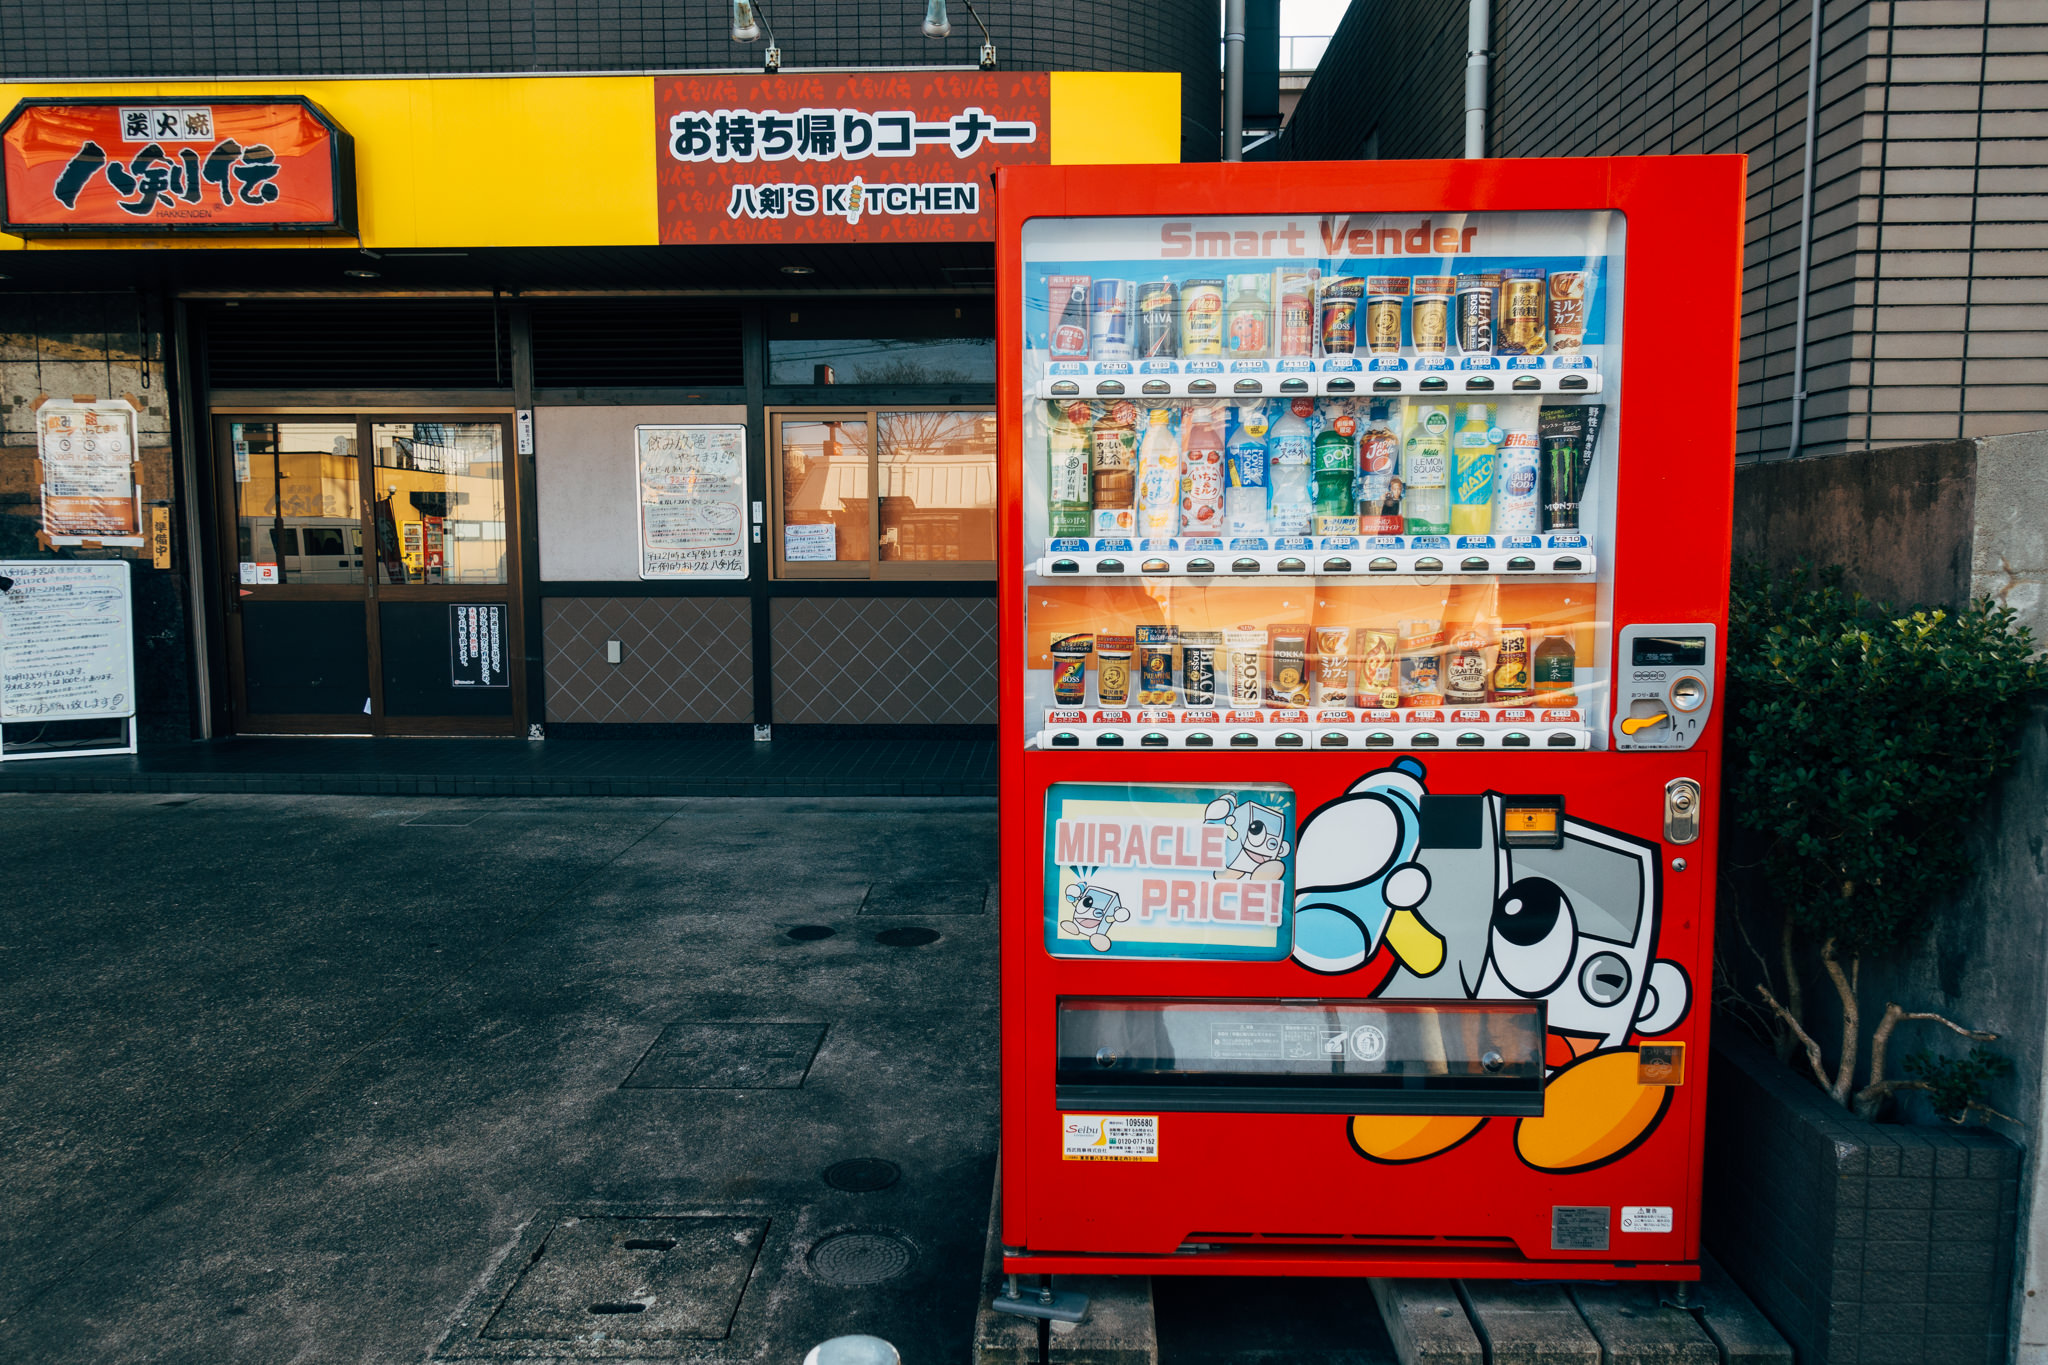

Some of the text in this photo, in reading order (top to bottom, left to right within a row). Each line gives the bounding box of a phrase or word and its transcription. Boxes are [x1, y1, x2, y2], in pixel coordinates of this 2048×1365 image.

[127, 112, 209, 137] 炭火焼
[675, 113, 1031, 157] お持ち帰りコーナー
[54, 138, 281, 216] 八剣伝
[156, 209, 212, 218] HAKKENDEN
[1161, 220, 1478, 257] Smart Vender
[1470, 294, 1478, 315] BOSS
[1553, 300, 1583, 312] ミルク
[1287, 310, 1309, 320] THE
[1477, 294, 1491, 349] BLACK
[1554, 313, 1582, 325] カフェ
[1332, 322, 1350, 330] BOSS
[647, 433, 707, 452] 飲み放題
[1504, 434, 1527, 447] BIG
[1583, 406, 1600, 466] 野性を解き放て
[1413, 466, 1444, 474] SQUASH
[1415, 458, 1443, 466] LEMON
[1067, 469, 1076, 498] 伊右衛門
[1192, 472, 1218, 482] いちご
[1458, 457, 1494, 495] MATCH
[1510, 481, 1534, 489] SODA
[1511, 472, 1534, 481] CALPIS
[1195, 487, 1218, 496] ミルク
[155, 521, 168, 557] 準備中
[1137, 628, 1149, 641] 新
[1192, 650, 1200, 671] BOSS
[1321, 656, 1348, 668] ミルク
[1551, 658, 1560, 680] 生茶
[1200, 651, 1214, 703] BLACK
[1244, 653, 1257, 701] BOSS
[1322, 667, 1348, 678] カフェ
[1058, 822, 1225, 868] MIRACLE
[1140, 879, 1283, 924] PRICE!
[1065, 1124, 1098, 1134] Seibu
